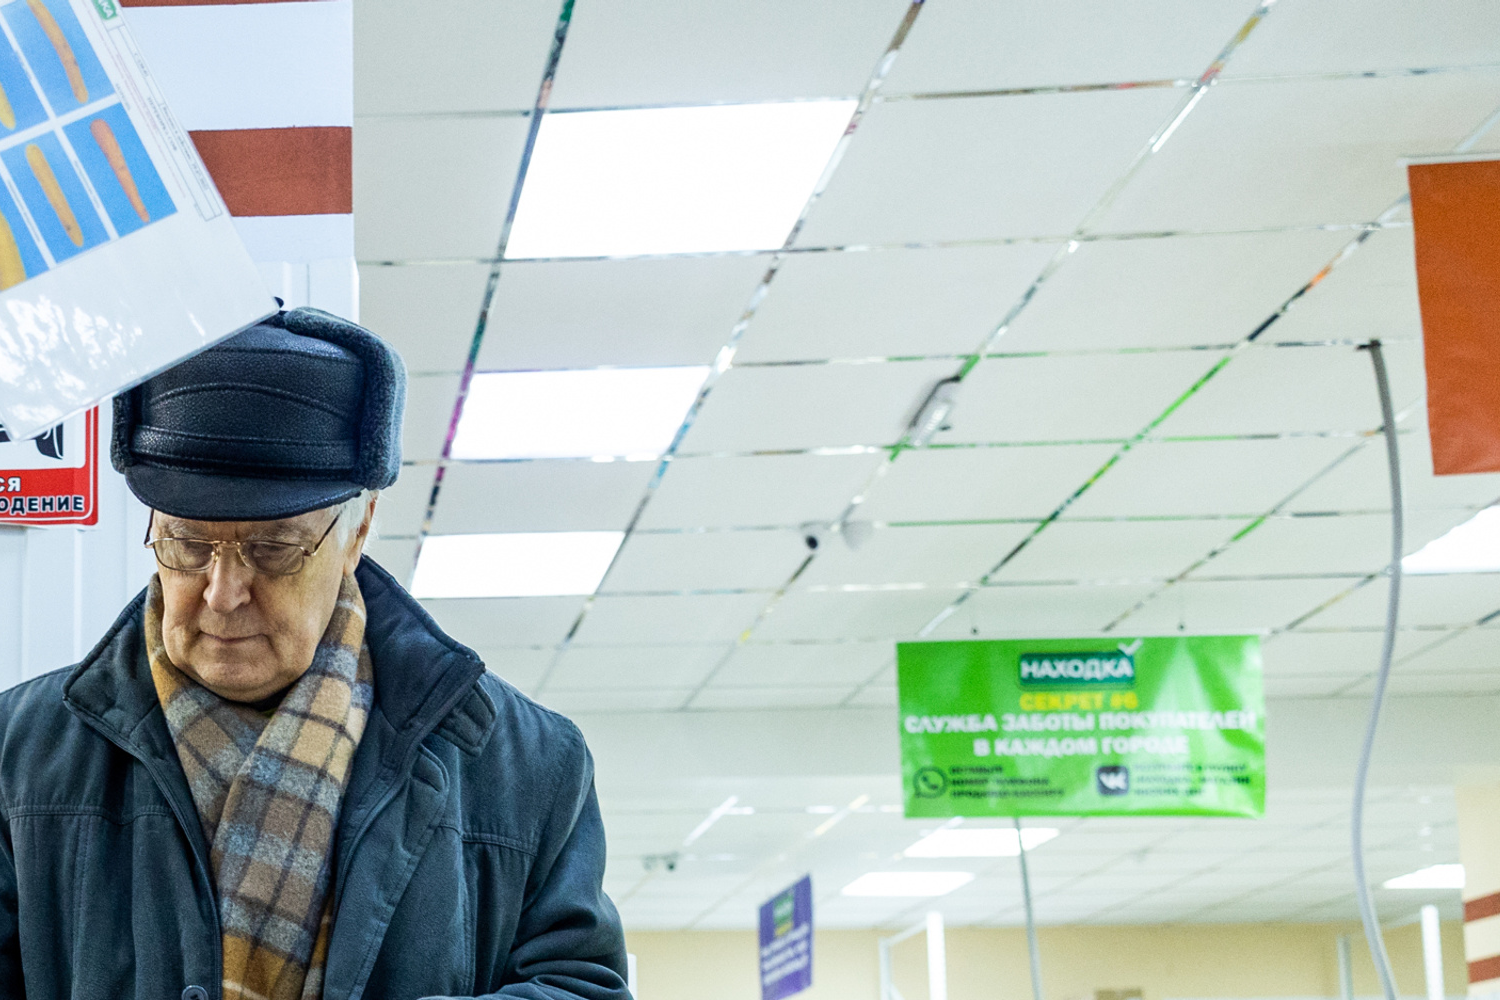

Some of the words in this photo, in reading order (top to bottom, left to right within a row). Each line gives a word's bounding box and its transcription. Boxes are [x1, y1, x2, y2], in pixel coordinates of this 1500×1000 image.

[1019, 656, 1134, 681] НАХОДКА
[1019, 691, 1104, 712] СЕКРЕТ
[904, 713, 998, 734] СЛУЖБА
[1001, 711, 1095, 732] ЗАБОТЫ
[1098, 710, 1257, 731] ПОКУПАТЕЛЕЙ
[973, 738, 991, 757] В
[994, 738, 1098, 758] КАЖДОМ
[1101, 735, 1189, 757] ГОРОДЕ
